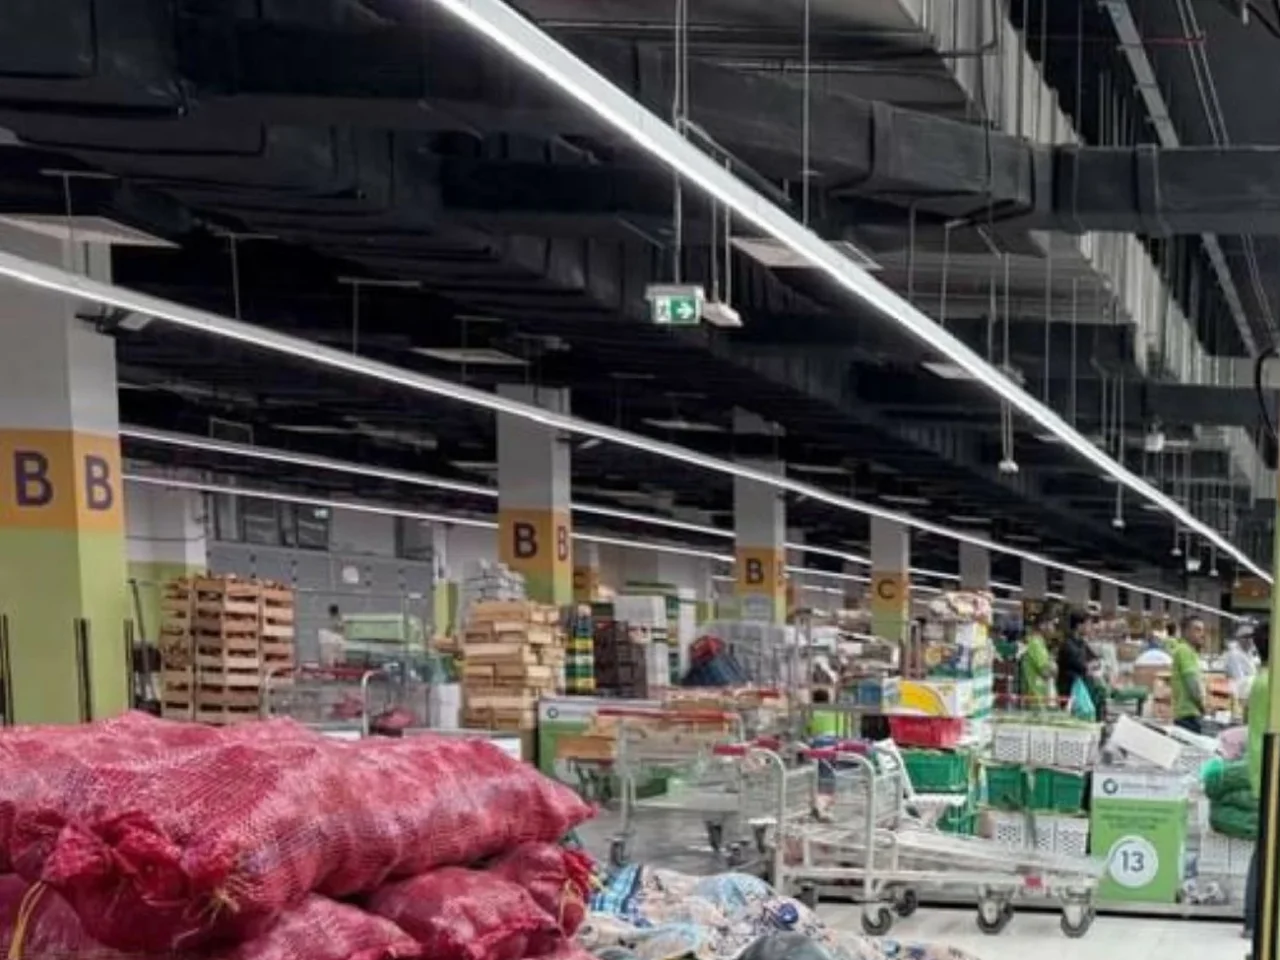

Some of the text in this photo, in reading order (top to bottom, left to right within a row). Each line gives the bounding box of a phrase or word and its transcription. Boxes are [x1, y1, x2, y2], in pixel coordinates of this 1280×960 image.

[14, 450, 54, 507] B
[84, 454, 113, 510] B
[513, 521, 537, 558] B
[745, 557, 764, 585] B
[877, 578, 898, 600] C
[1121, 850, 1145, 872] 13
